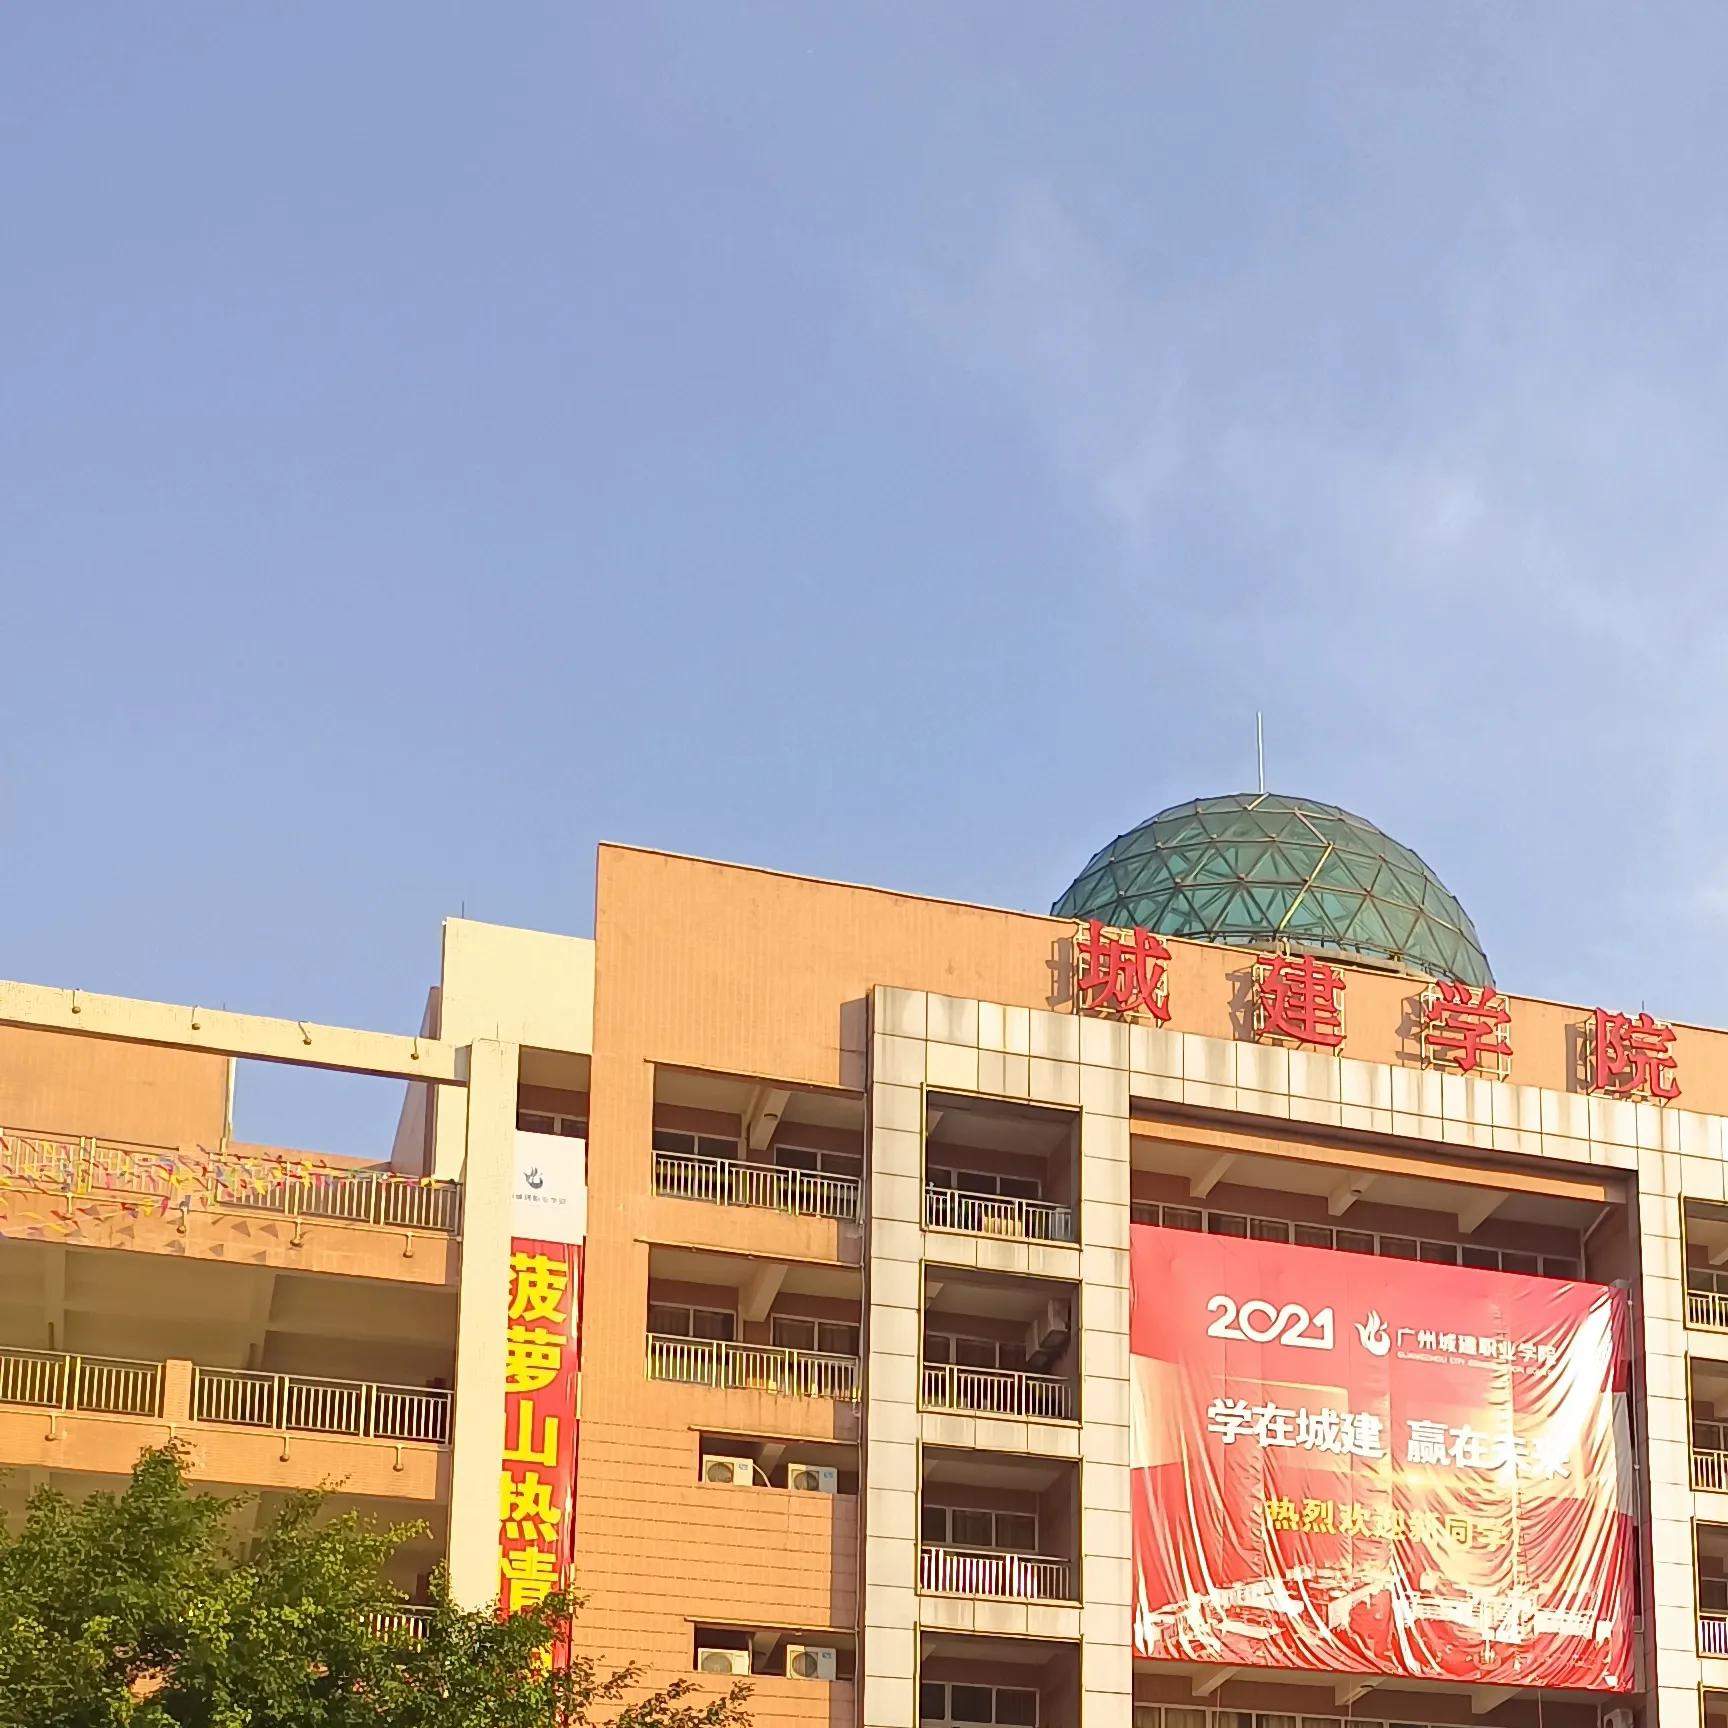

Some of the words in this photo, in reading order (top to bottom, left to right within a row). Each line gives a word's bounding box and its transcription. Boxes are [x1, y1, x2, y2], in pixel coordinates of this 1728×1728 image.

[1077, 918, 1682, 1099] 城建学院
[1207, 1295, 1335, 1350] 2021
[1397, 1327, 1558, 1366] 广州城建职业学院
[1207, 1397, 1387, 1459] 学在城建
